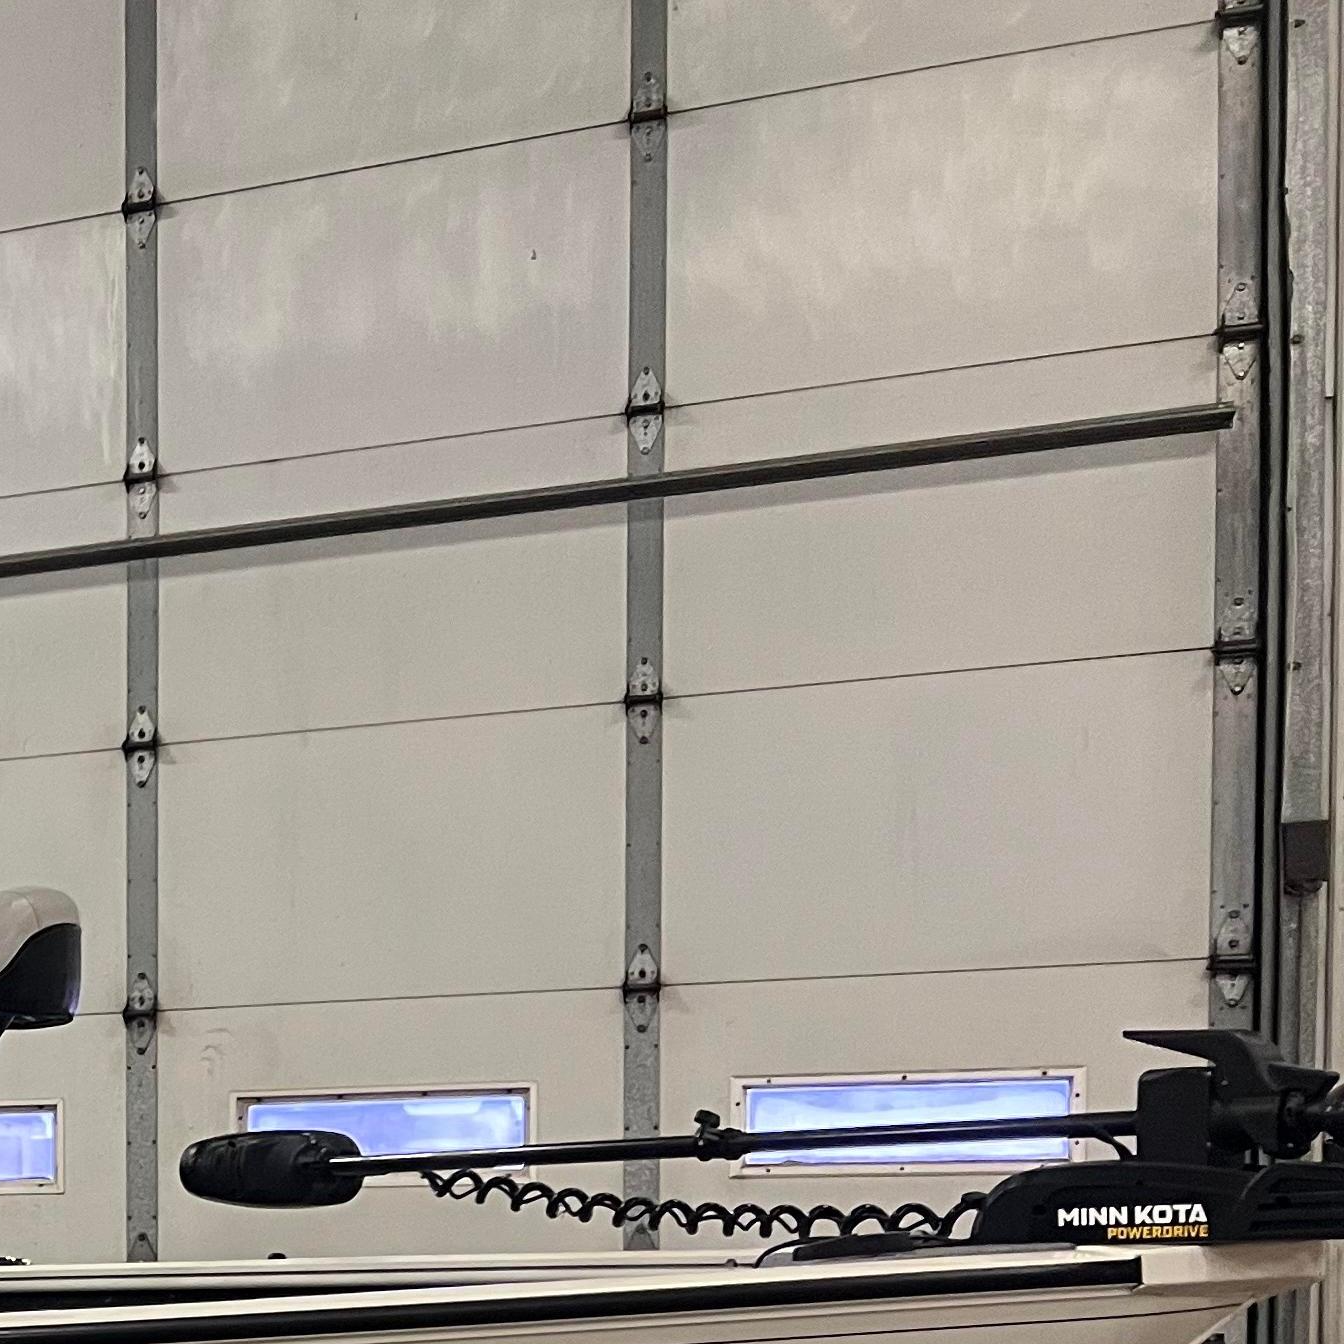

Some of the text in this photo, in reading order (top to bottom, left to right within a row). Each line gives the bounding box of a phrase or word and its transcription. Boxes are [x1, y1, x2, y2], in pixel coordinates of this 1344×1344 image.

[1057, 1203, 1208, 1227] MINN KOTA
[1107, 1224, 1209, 1240] POWERDRIVE
